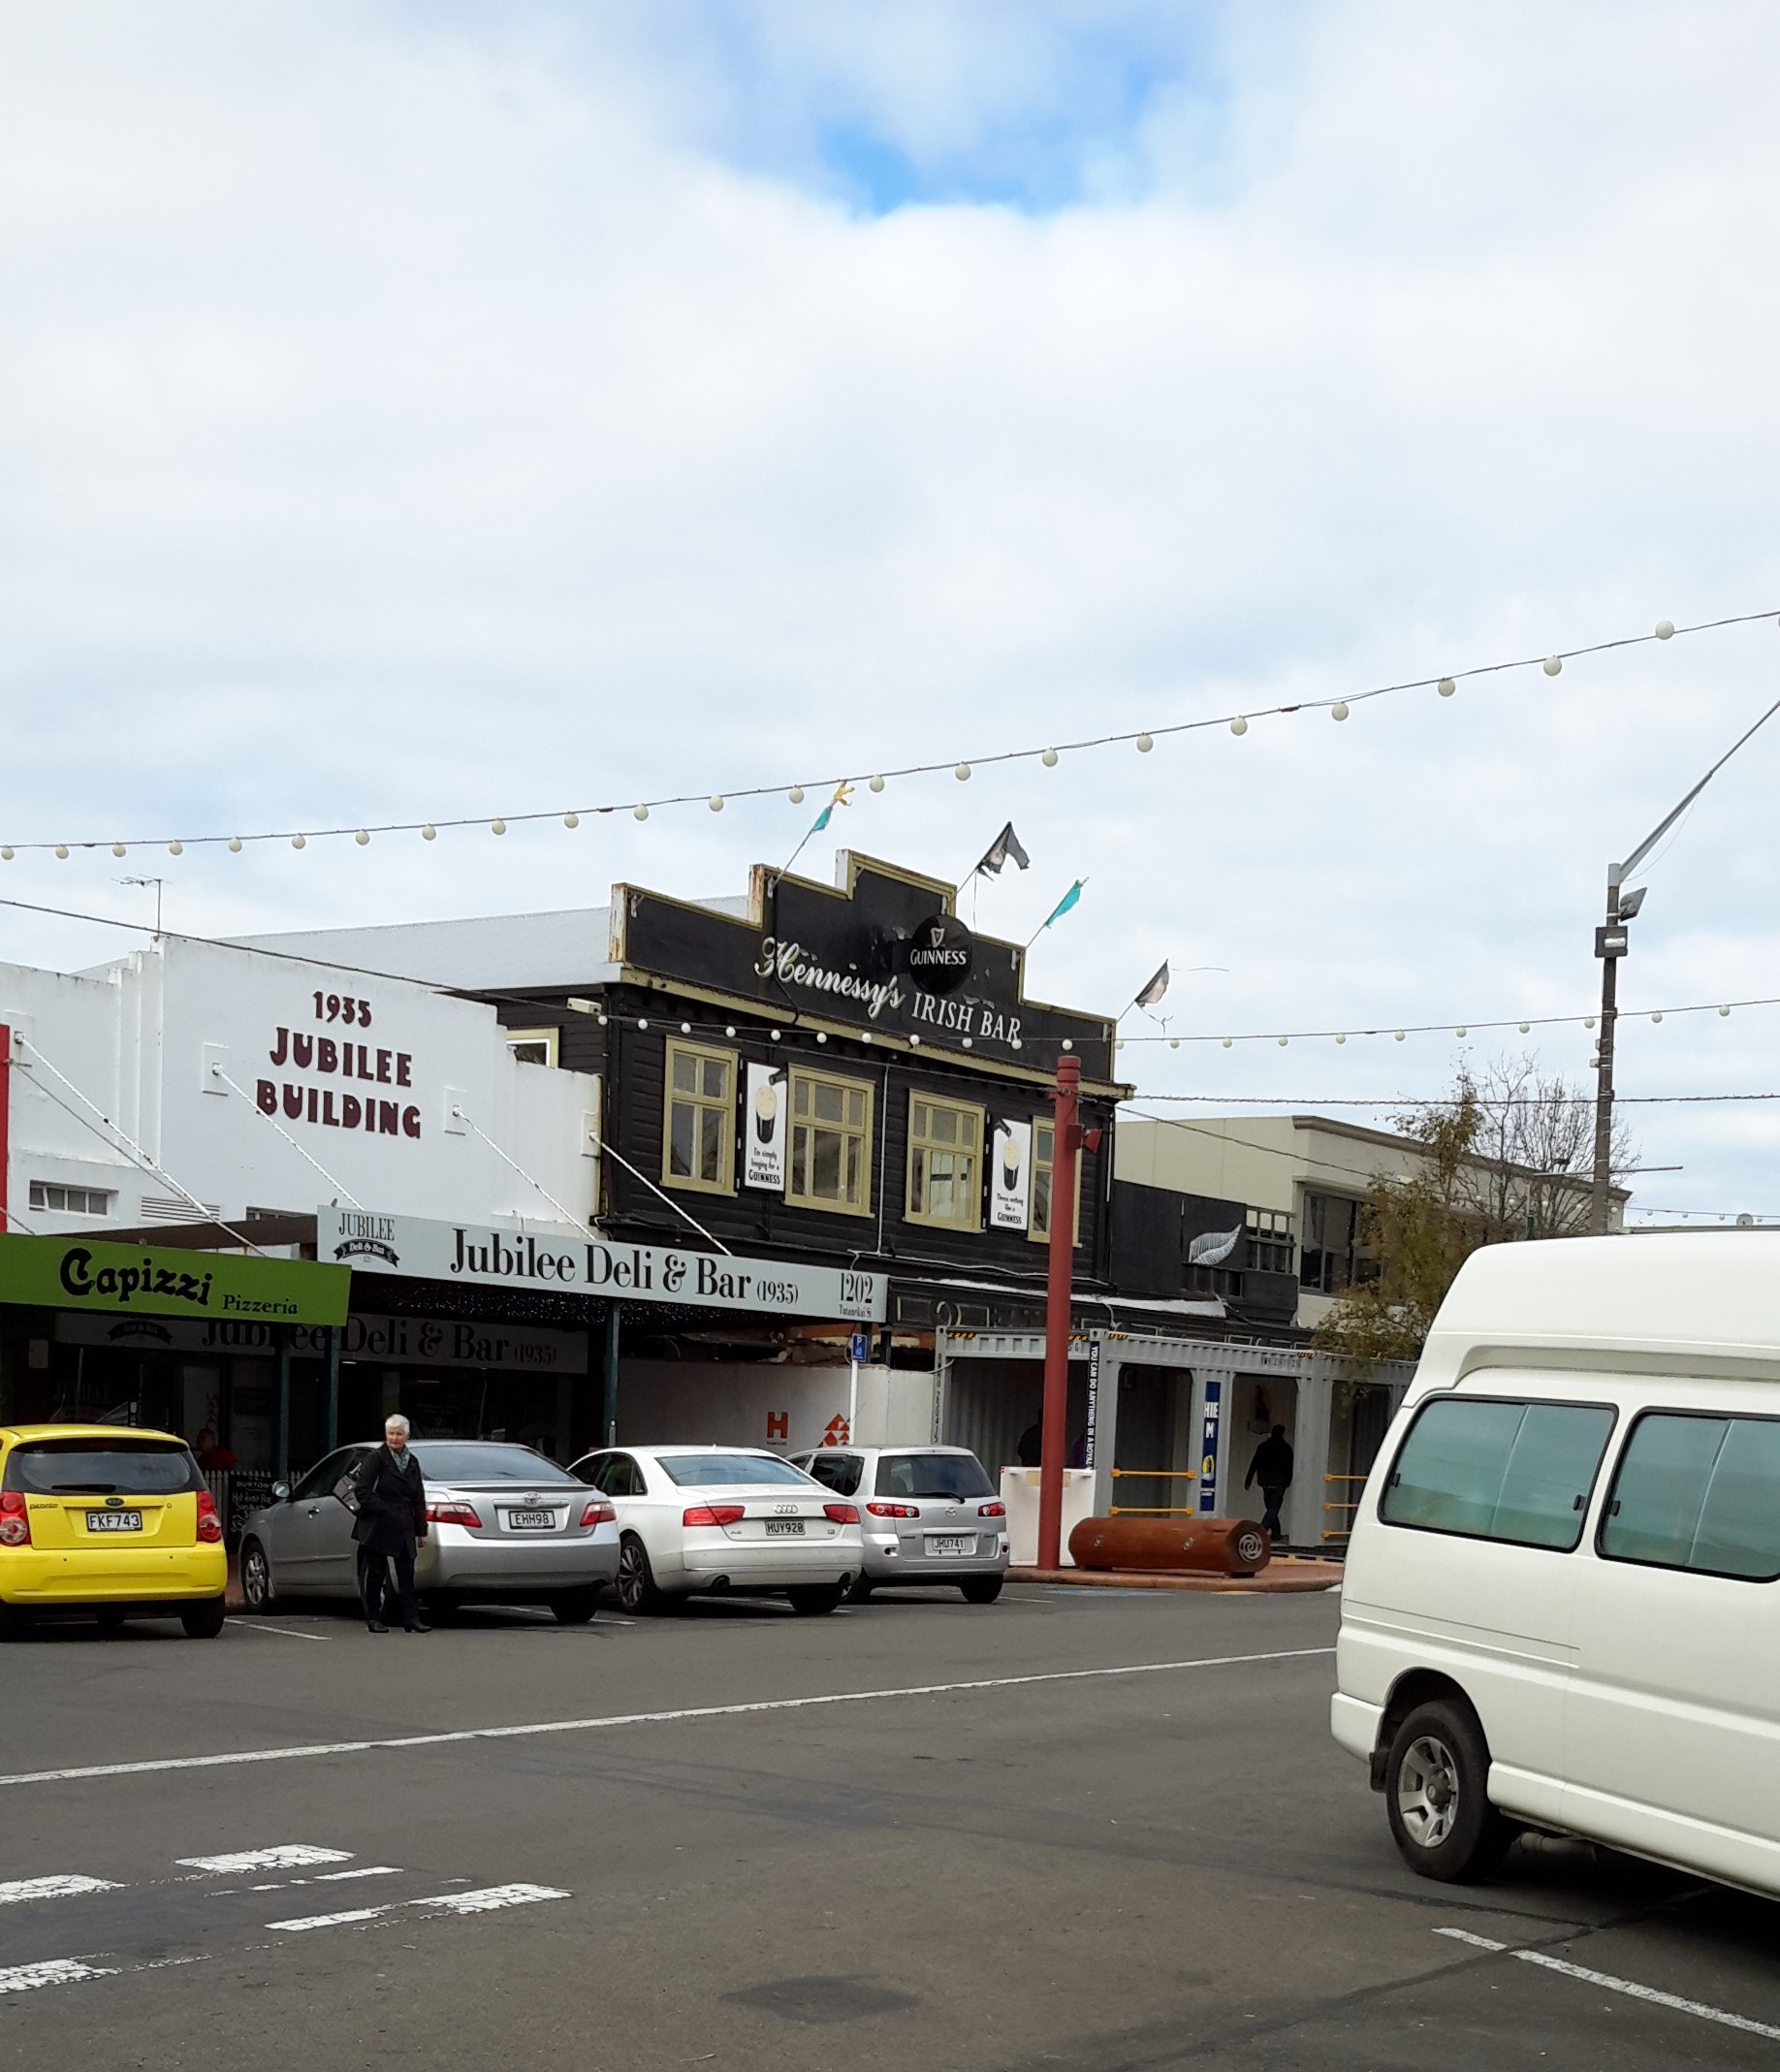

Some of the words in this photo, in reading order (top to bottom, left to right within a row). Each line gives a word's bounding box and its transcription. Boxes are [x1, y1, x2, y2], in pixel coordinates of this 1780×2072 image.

[909, 948, 967, 966] GUINNESS
[754, 937, 906, 1019] Hennessy's
[911, 992, 973, 1033] IRISH
[979, 1010, 1021, 1043] BAR
[313, 991, 371, 1028] 1935
[270, 1027, 412, 1087] JUBILEE
[256, 1078, 421, 1139] BUILDING
[748, 1168, 780, 1185] GUINNESS
[338, 1213, 395, 1241] JUBILEE
[997, 1211, 1022, 1225] GUINNESS
[60, 1248, 213, 1306] Capizzi
[450, 1227, 576, 1282] Jubilee
[584, 1243, 652, 1290] Deli
[662, 1255, 687, 1292] &
[695, 1258, 751, 1298] Bar
[756, 1280, 799, 1304] (1935)
[840, 1272, 873, 1303] 1202
[222, 1294, 298, 1315] Pizzeria
[341, 1317, 408, 1355] Deli
[419, 1322, 443, 1355] &
[454, 1323, 510, 1362] Bar
[1091, 1346, 1099, 1360] YOU
[1090, 1362, 1098, 1377] CAN
[767, 1412, 788, 1439] H
[89, 1514, 140, 1528] FKF743
[515, 1513, 550, 1525] EHH98
